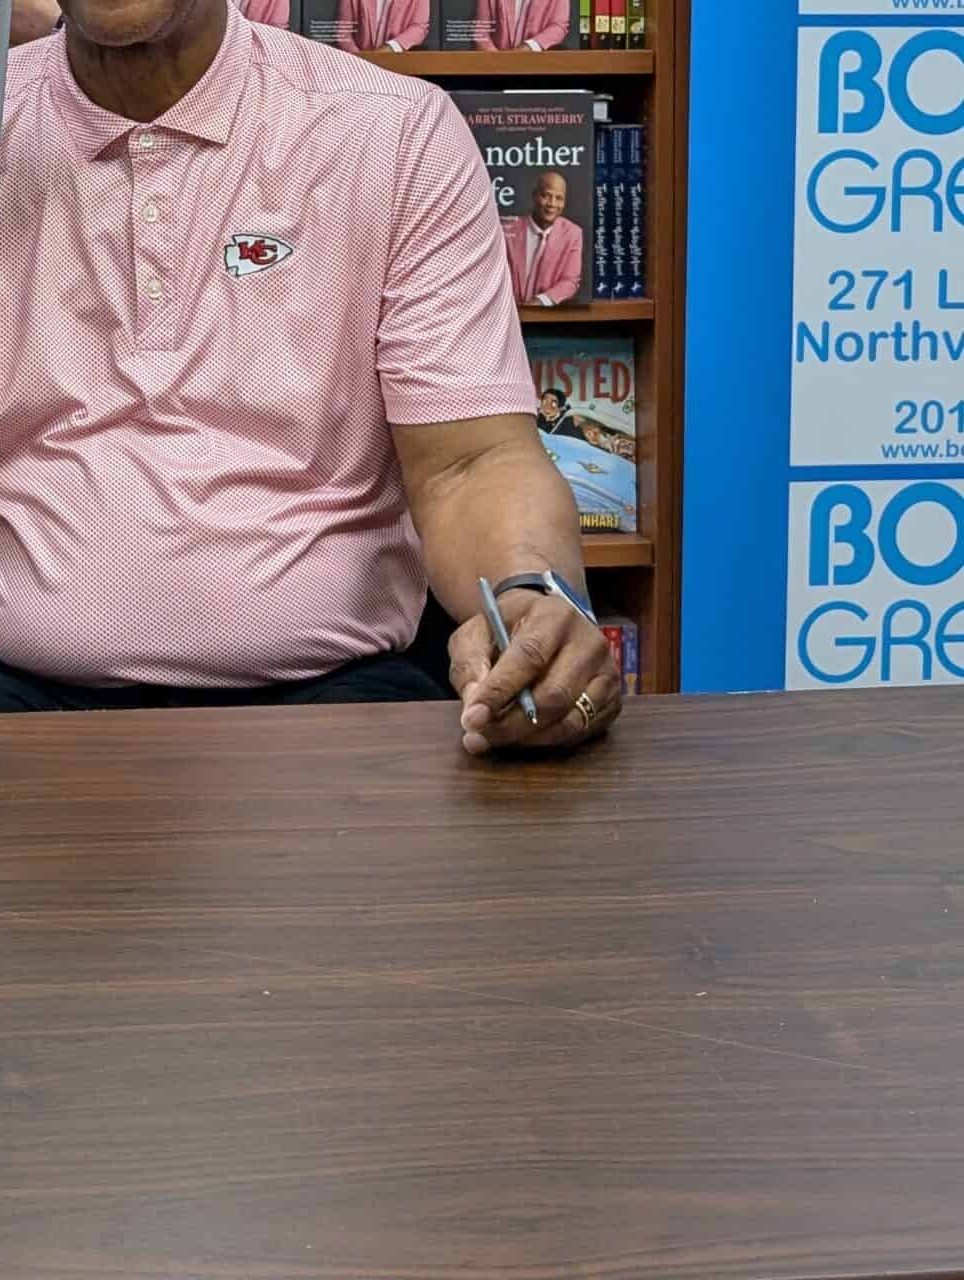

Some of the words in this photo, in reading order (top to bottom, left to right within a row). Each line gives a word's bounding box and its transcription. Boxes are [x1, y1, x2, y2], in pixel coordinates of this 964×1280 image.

[817, 30, 964, 136] BO
[506, 113, 585, 126] STRAWBERRY
[486, 136, 585, 166] nother
[828, 269, 913, 311] 271
[809, 482, 964, 586] BO
